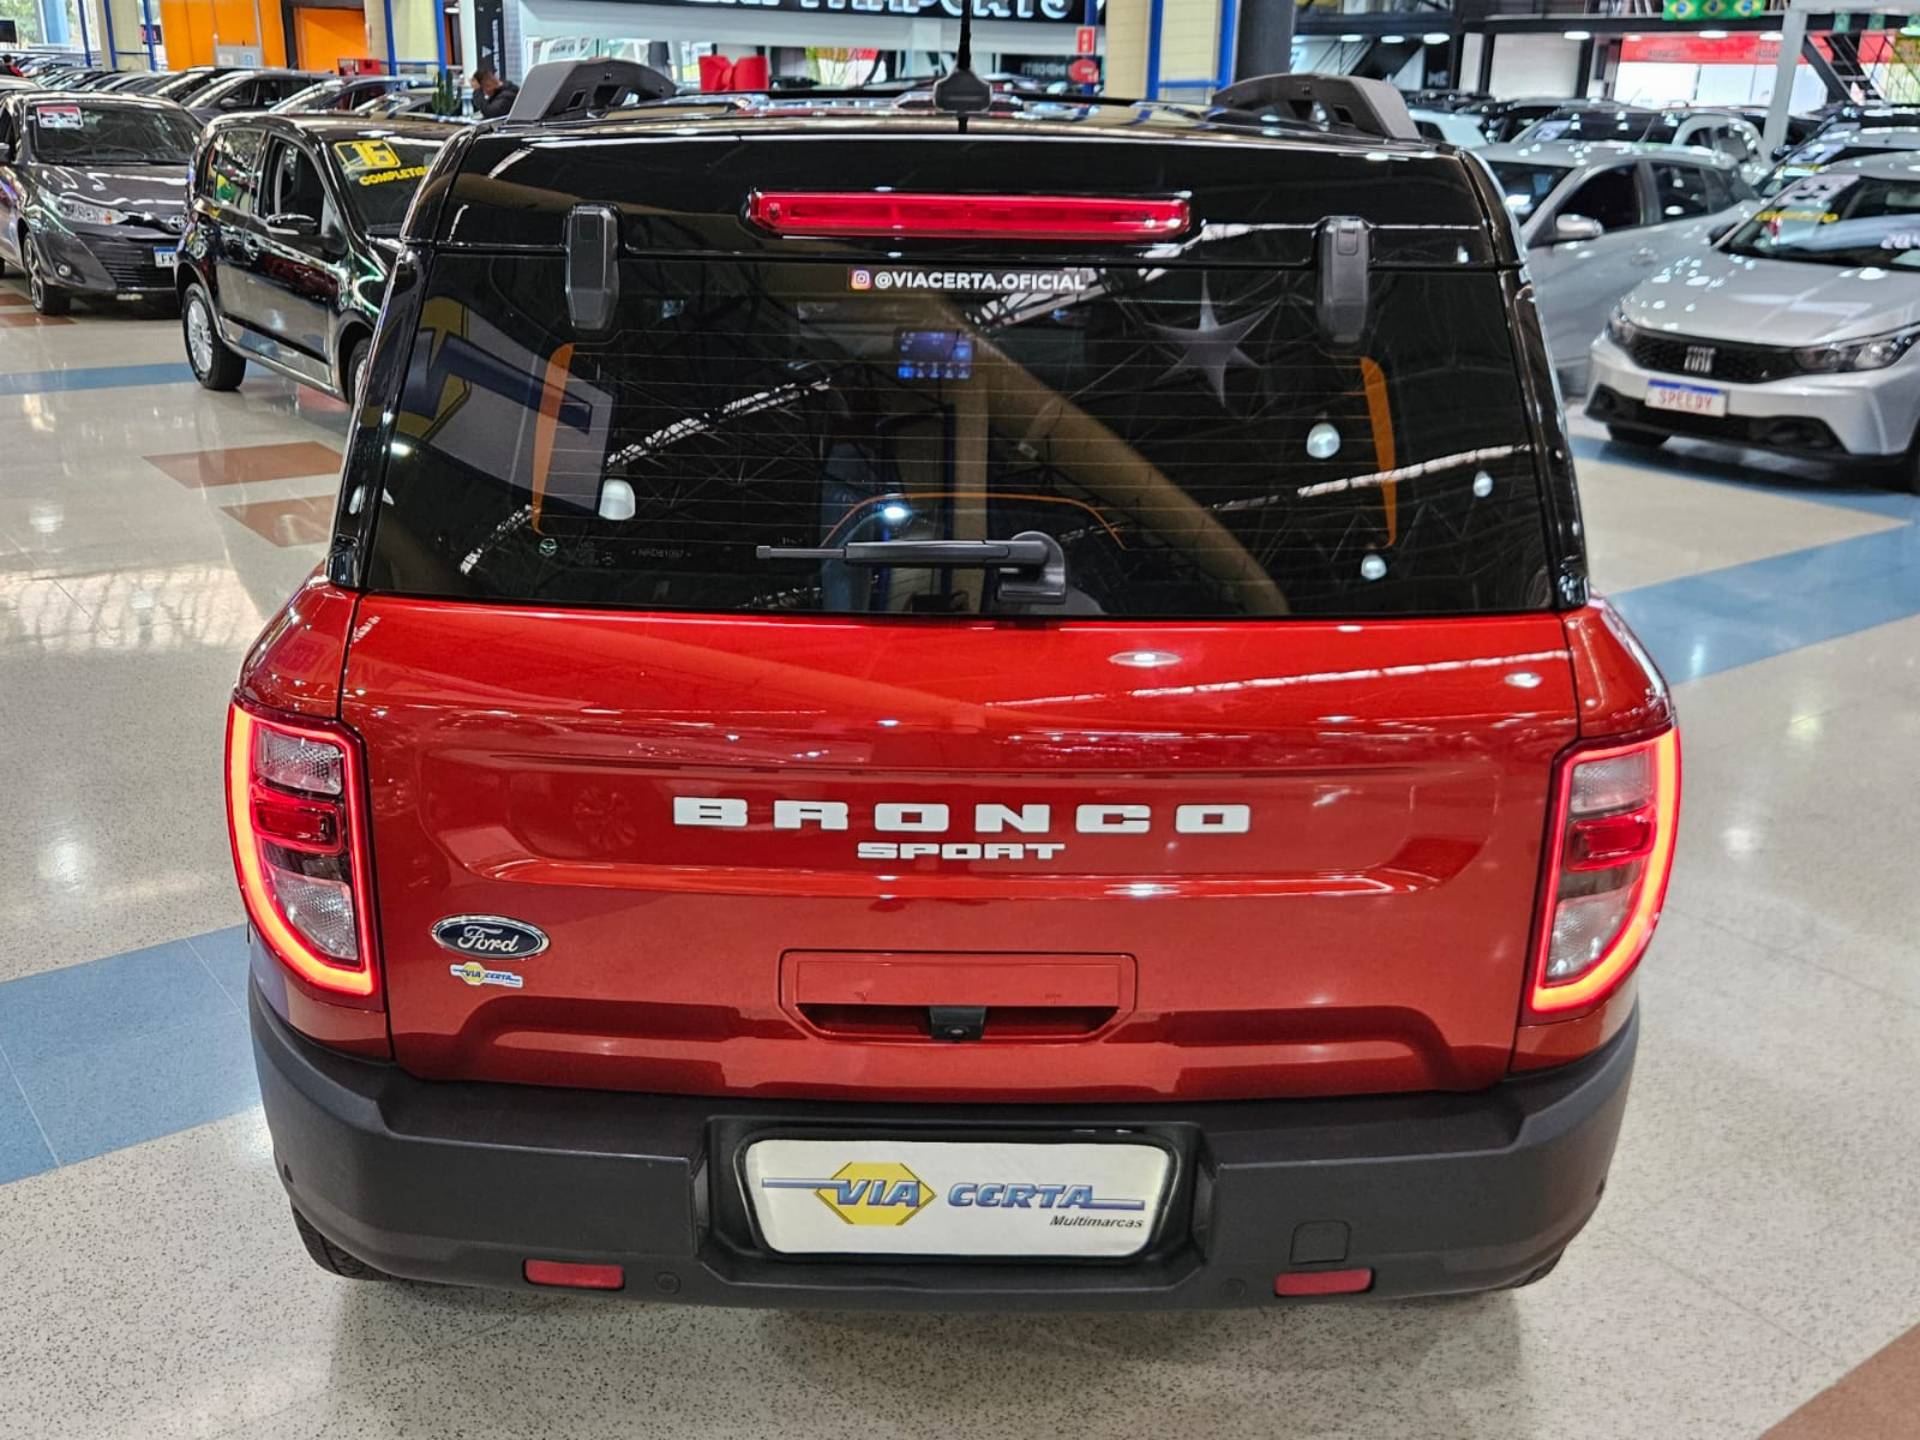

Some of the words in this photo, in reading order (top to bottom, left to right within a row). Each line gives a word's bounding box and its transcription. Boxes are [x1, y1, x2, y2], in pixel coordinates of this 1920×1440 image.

[874, 271, 1086, 291] @VIACERTA.OFICIAL
[673, 796, 1251, 833] BRONCO
[857, 842, 1065, 860] SPORT
[457, 925, 519, 953] Ford
[485, 972, 512, 980] CERTA
[837, 1179, 920, 1207] VIA
[948, 1183, 1094, 1209] CERTA
[1049, 1215, 1144, 1229] Multimarcas
